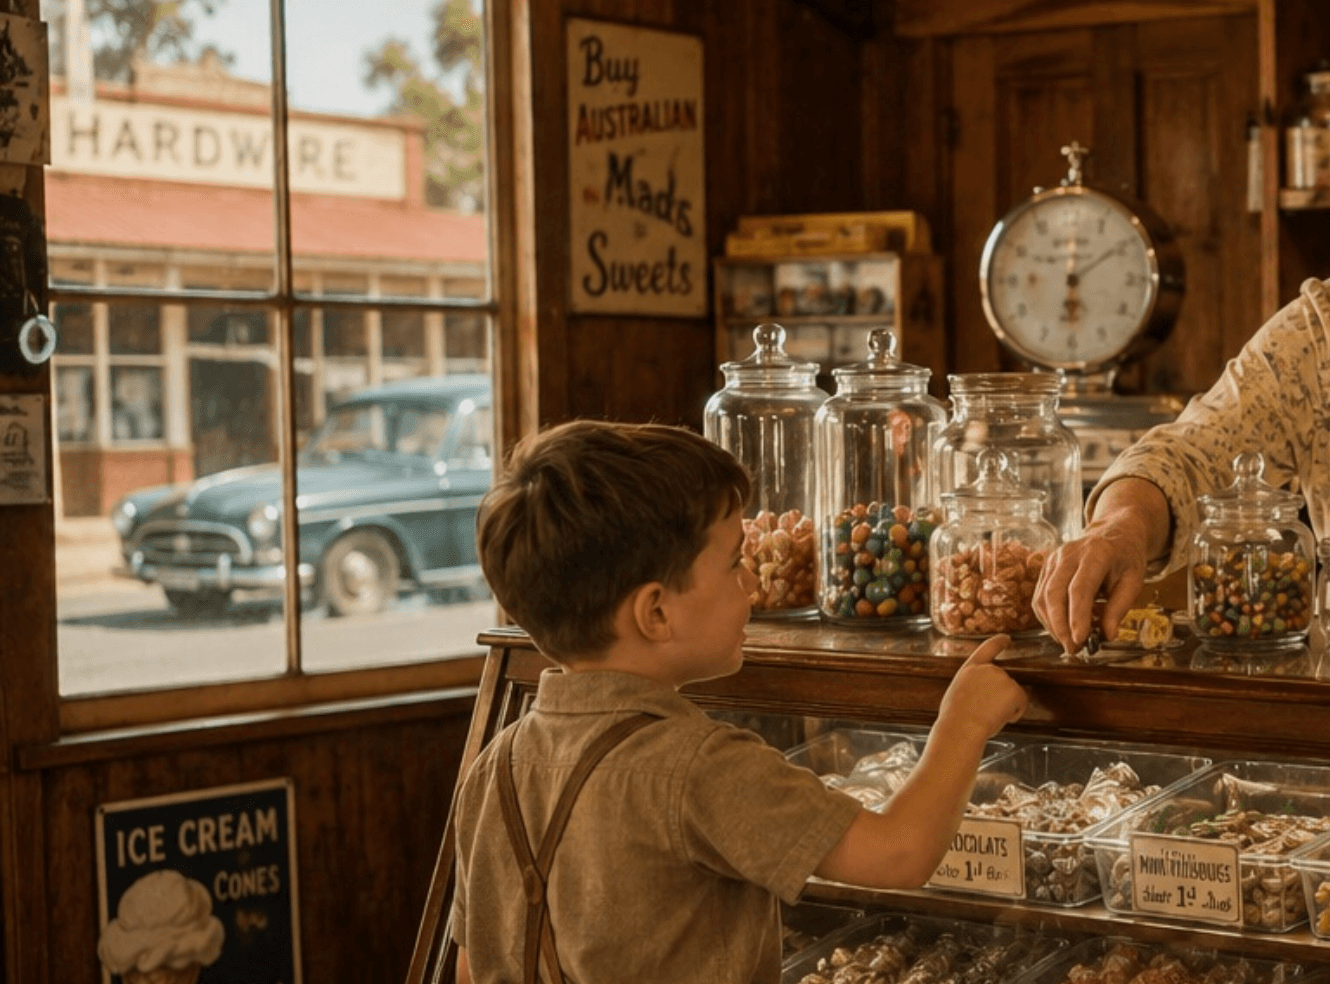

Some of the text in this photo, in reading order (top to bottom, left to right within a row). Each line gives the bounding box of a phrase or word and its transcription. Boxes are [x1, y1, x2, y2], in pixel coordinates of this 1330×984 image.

[579, 35, 640, 98] Buy
[65, 111, 358, 181] HARDWRE
[575, 98, 698, 145] AUSTRALIAN
[582, 228, 694, 298] Sweets
[116, 806, 279, 869] ICE CREAM
[213, 863, 281, 901] CONES
